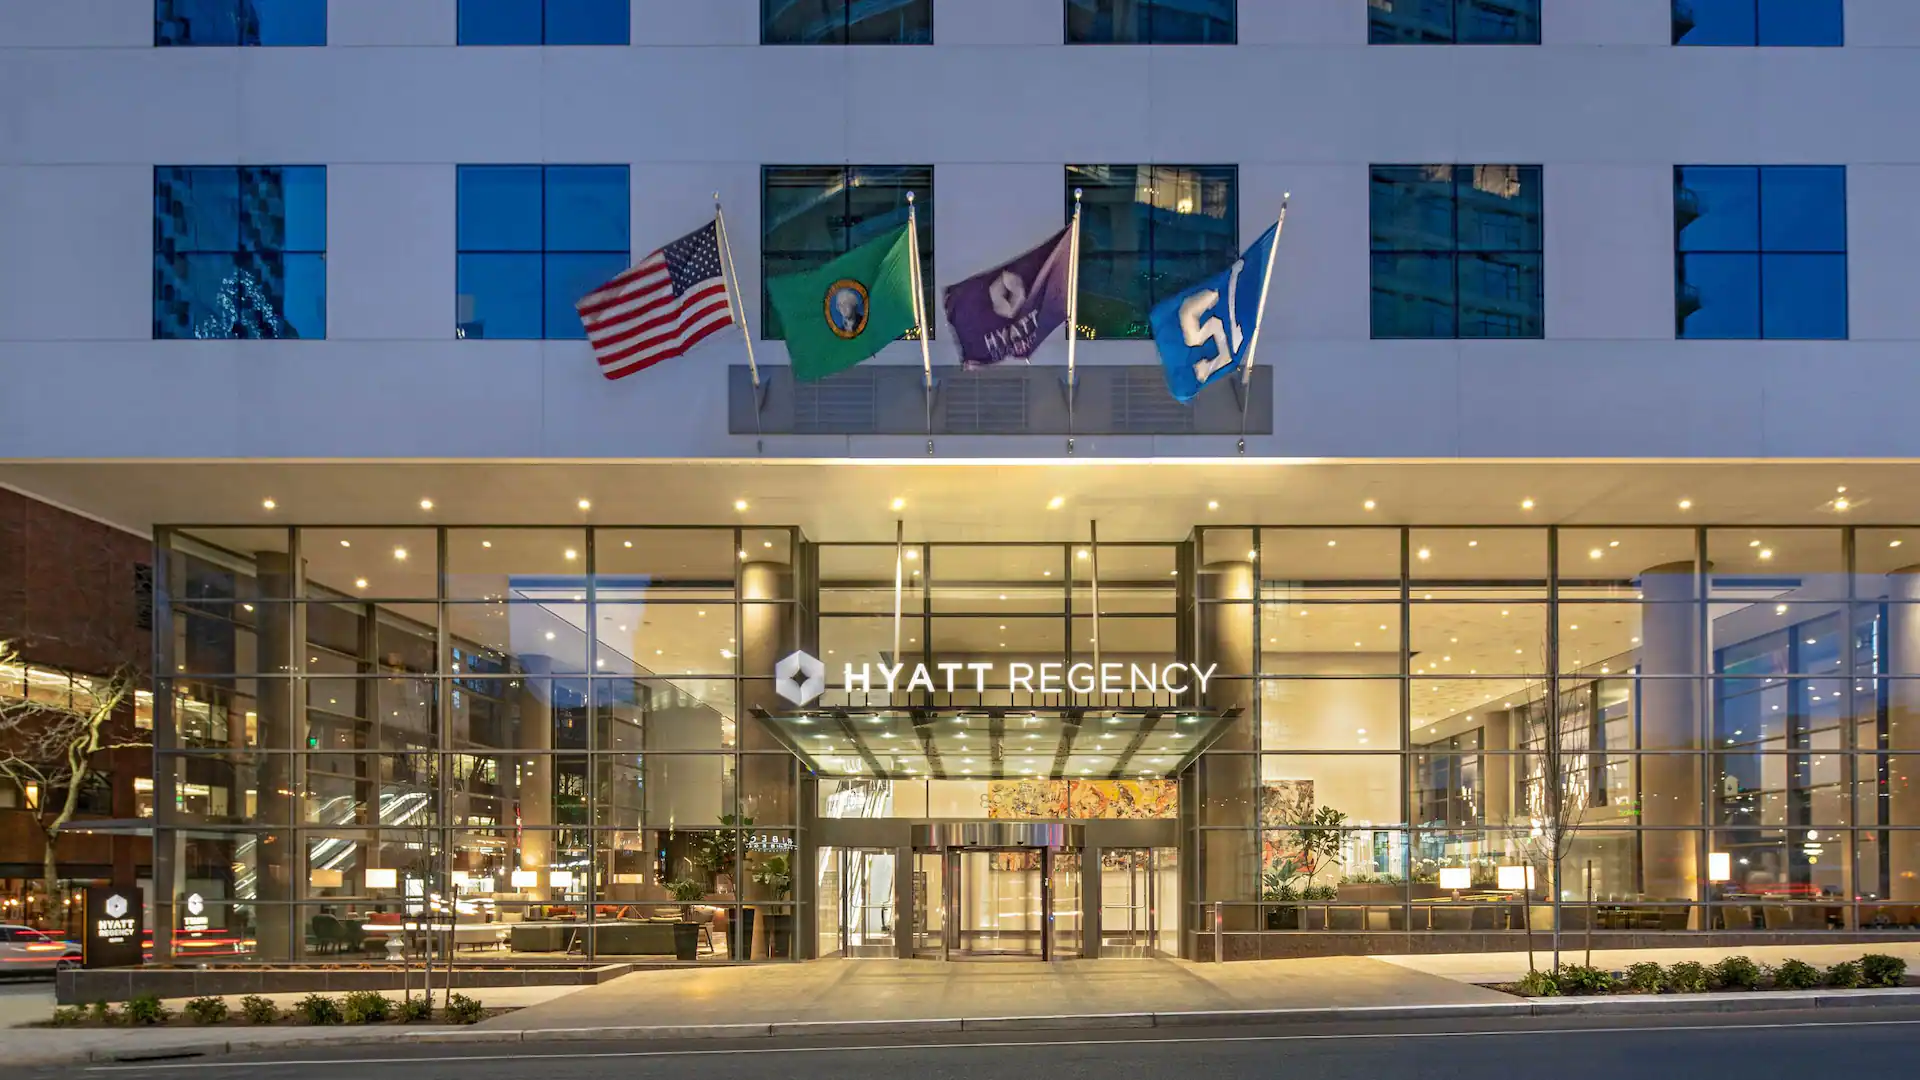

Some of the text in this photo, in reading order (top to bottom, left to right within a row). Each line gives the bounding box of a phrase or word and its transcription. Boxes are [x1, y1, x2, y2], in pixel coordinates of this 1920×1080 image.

[984, 310, 1038, 352] HYATT
[844, 662, 1218, 694] HYATT REGENCY
[98, 919, 135, 930] HYATT
